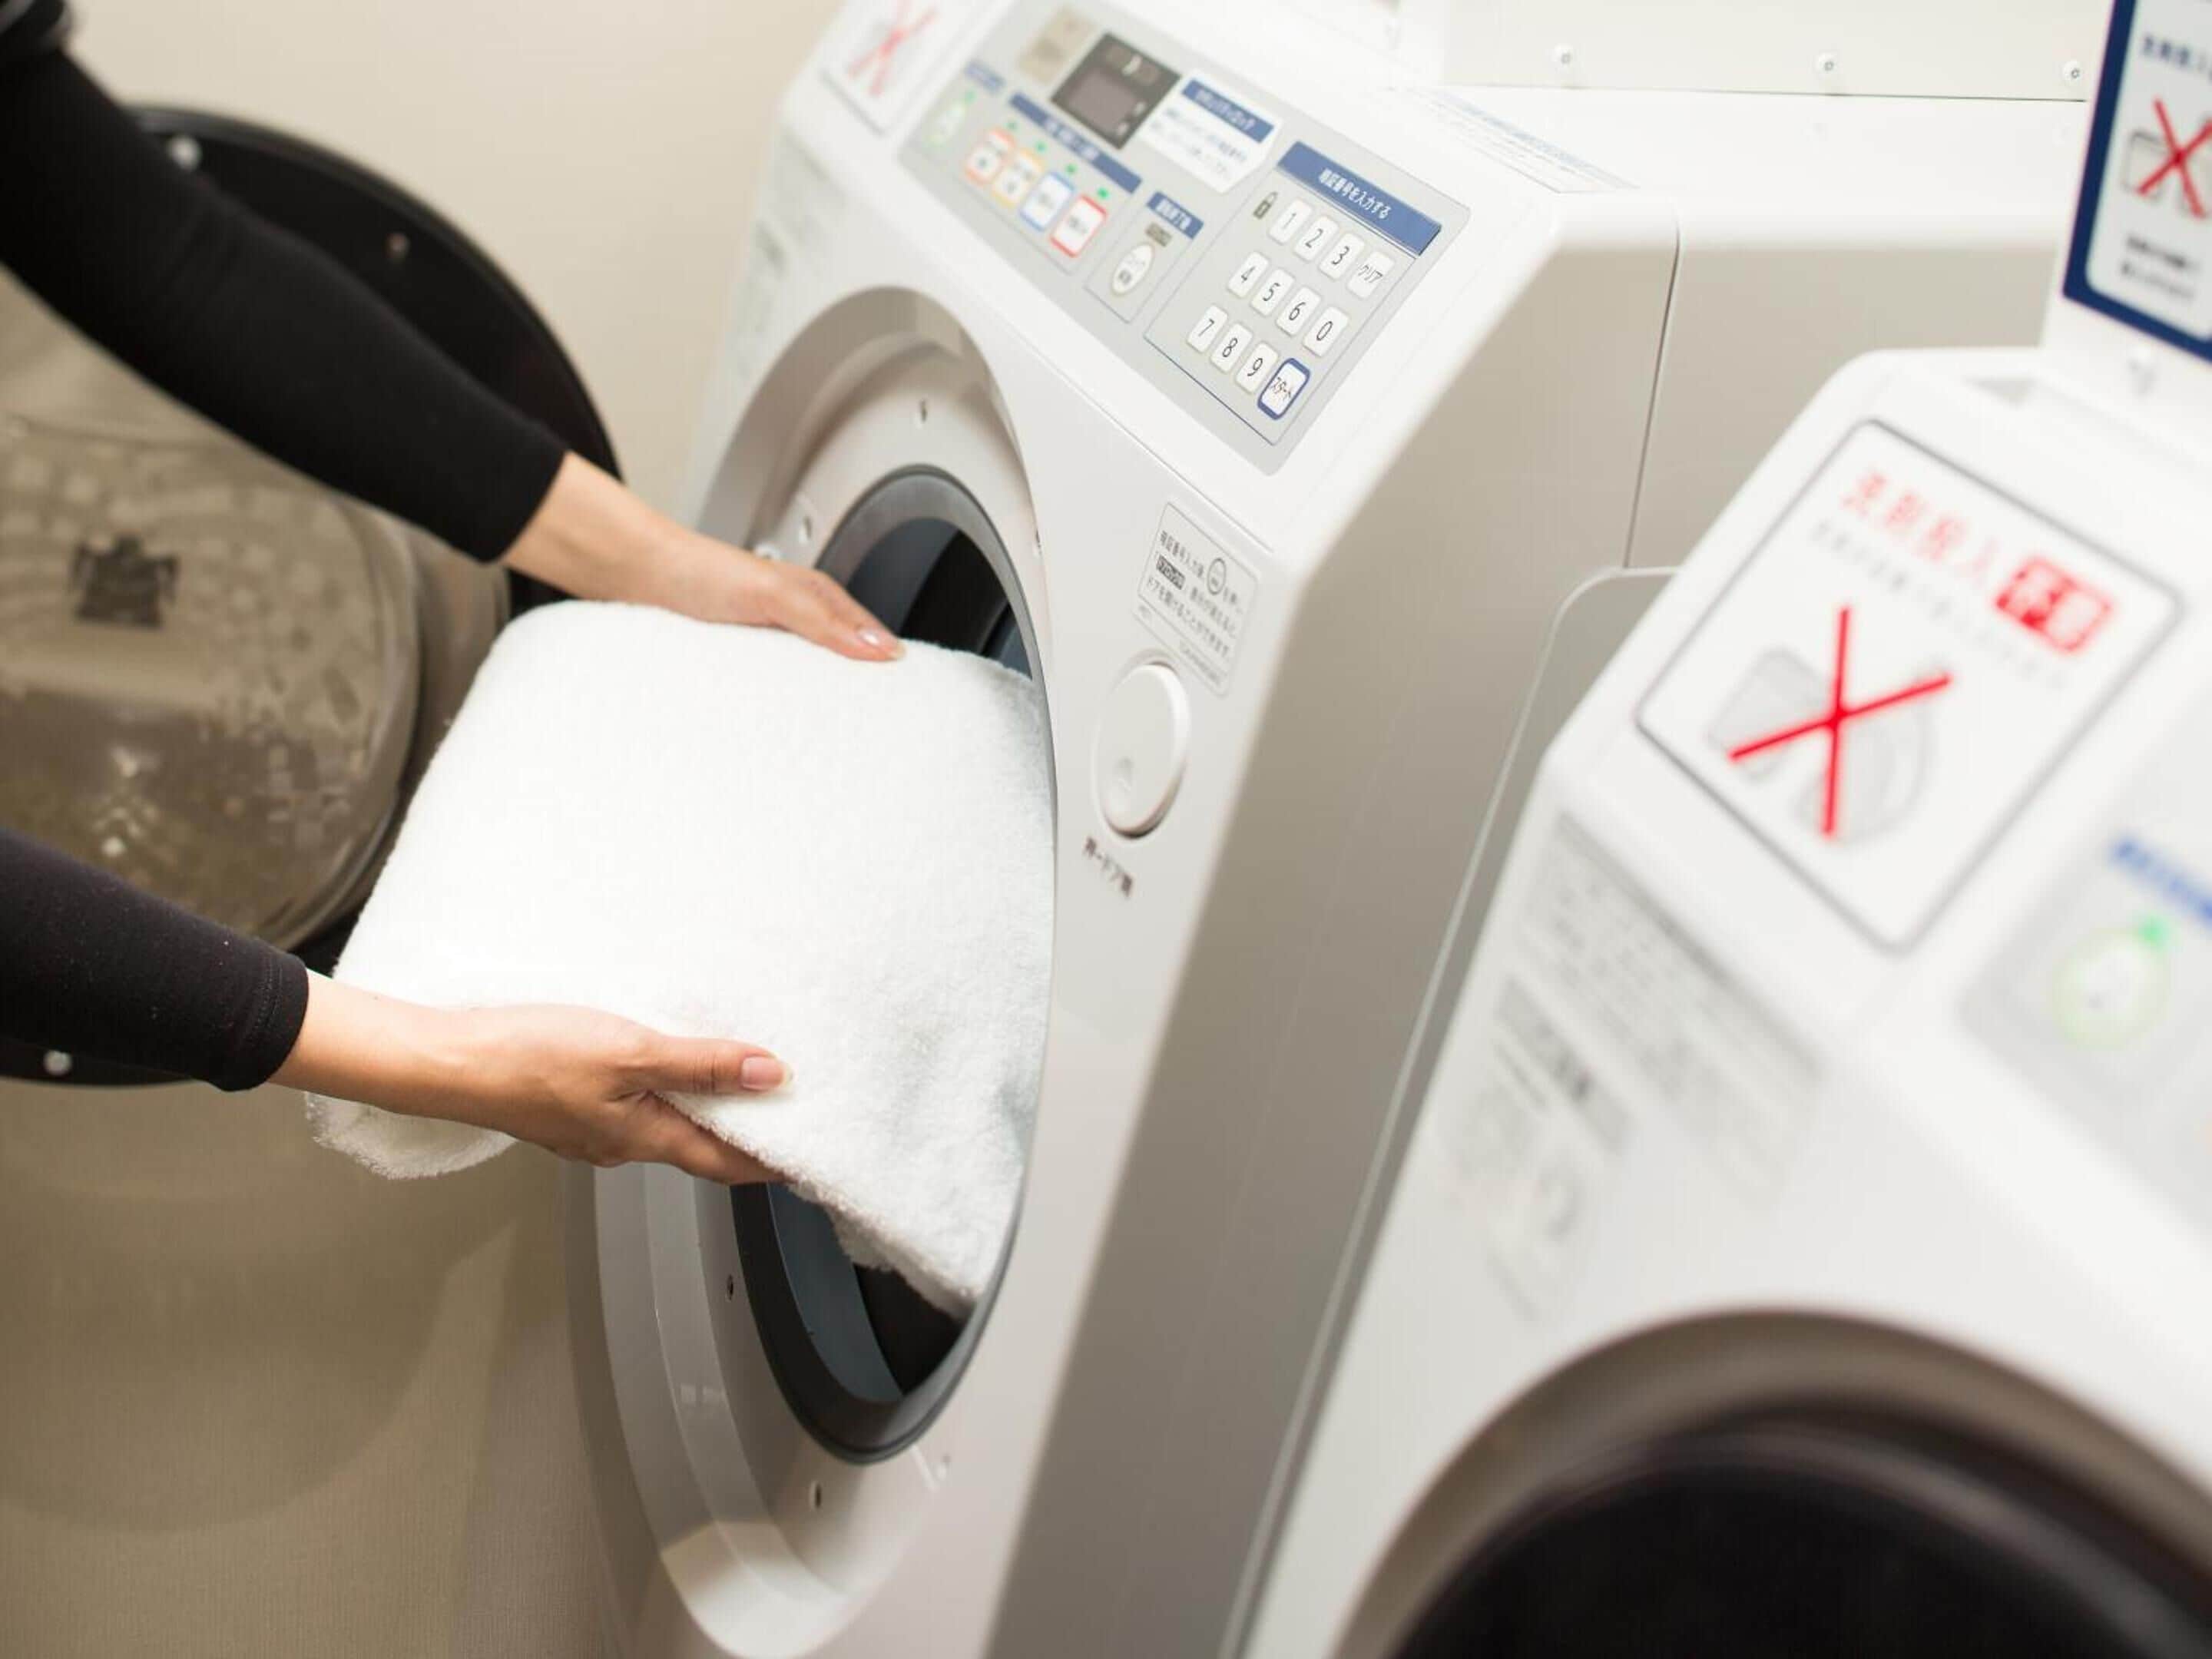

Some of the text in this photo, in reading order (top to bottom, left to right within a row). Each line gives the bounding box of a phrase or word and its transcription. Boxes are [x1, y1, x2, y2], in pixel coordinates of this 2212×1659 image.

[1284, 212, 1349, 265] 1 2 3
[1357, 265, 1383, 283] クリア
[1240, 266, 1333, 341] 4 5 6 0
[1197, 319, 1263, 376] 7 8 9
